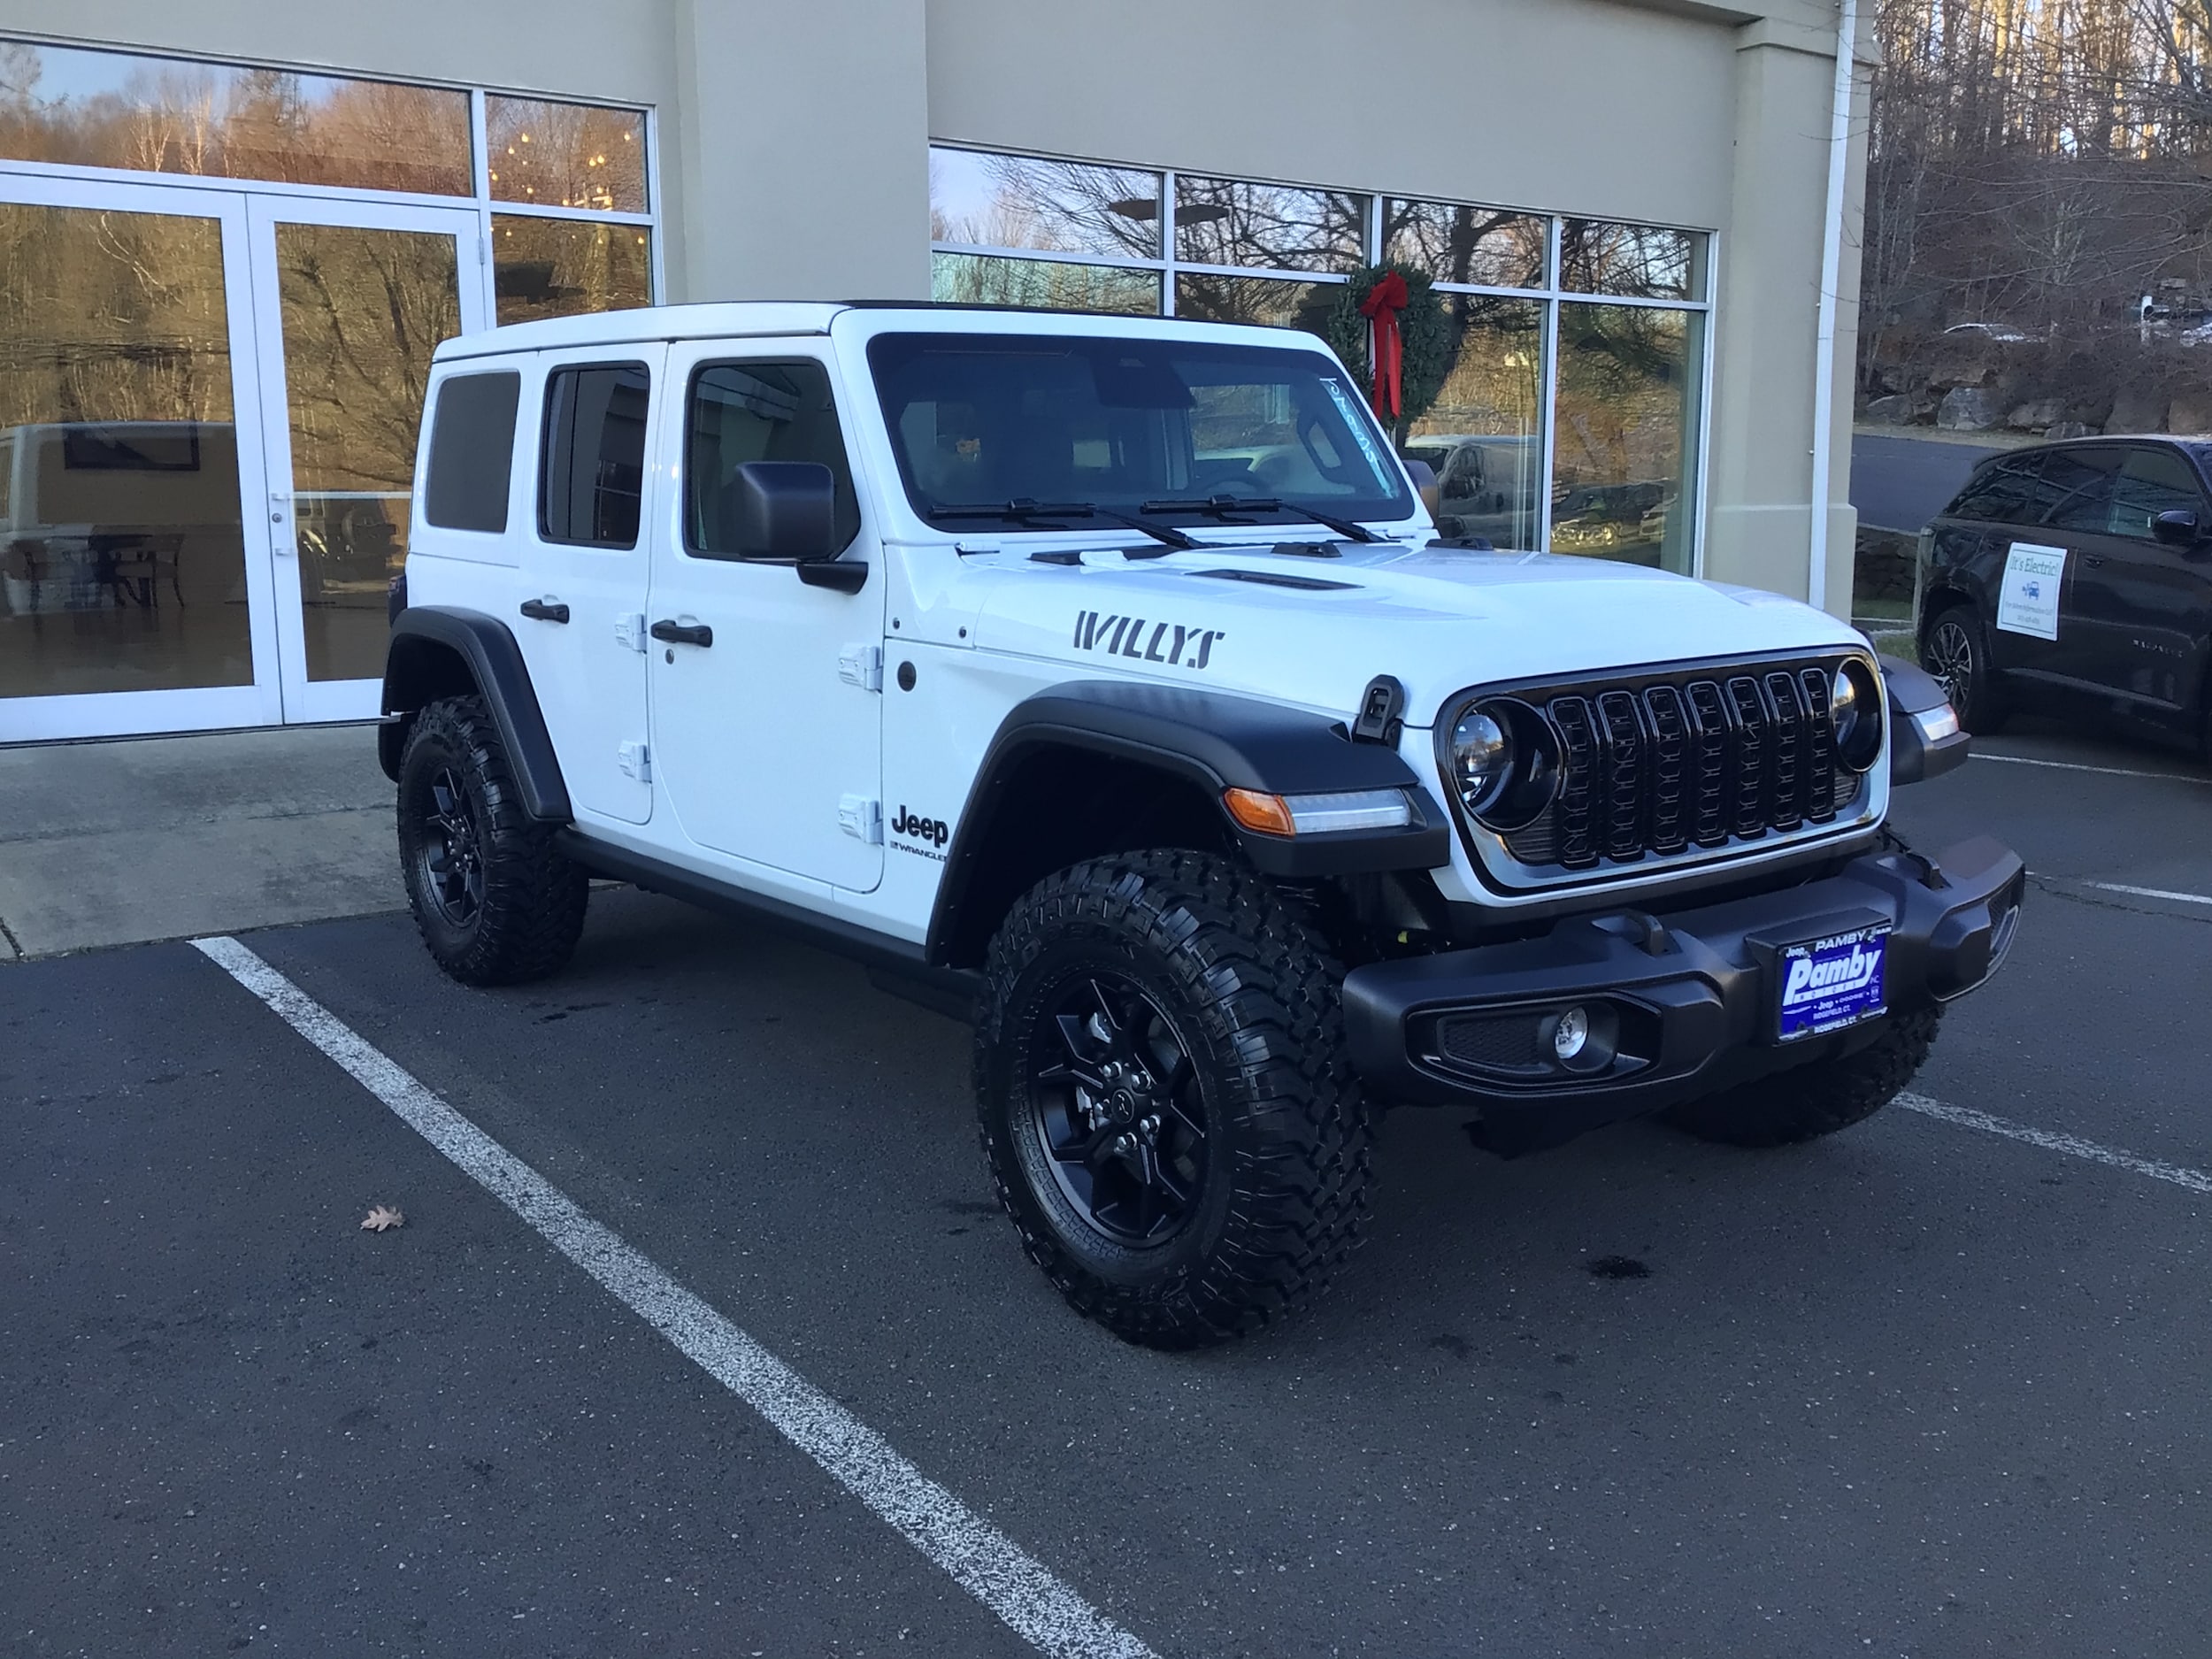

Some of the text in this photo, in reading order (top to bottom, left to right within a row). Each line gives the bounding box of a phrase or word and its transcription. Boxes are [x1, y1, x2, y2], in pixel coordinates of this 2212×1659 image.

[2010, 556, 2024, 572] It's
[1073, 611, 1226, 670] WILLYS
[891, 804, 949, 849] Jeep
[899, 842, 948, 863] WRANGLE
[1815, 930, 1866, 952] PAMBY
[1782, 944, 1883, 1006] Pamby
